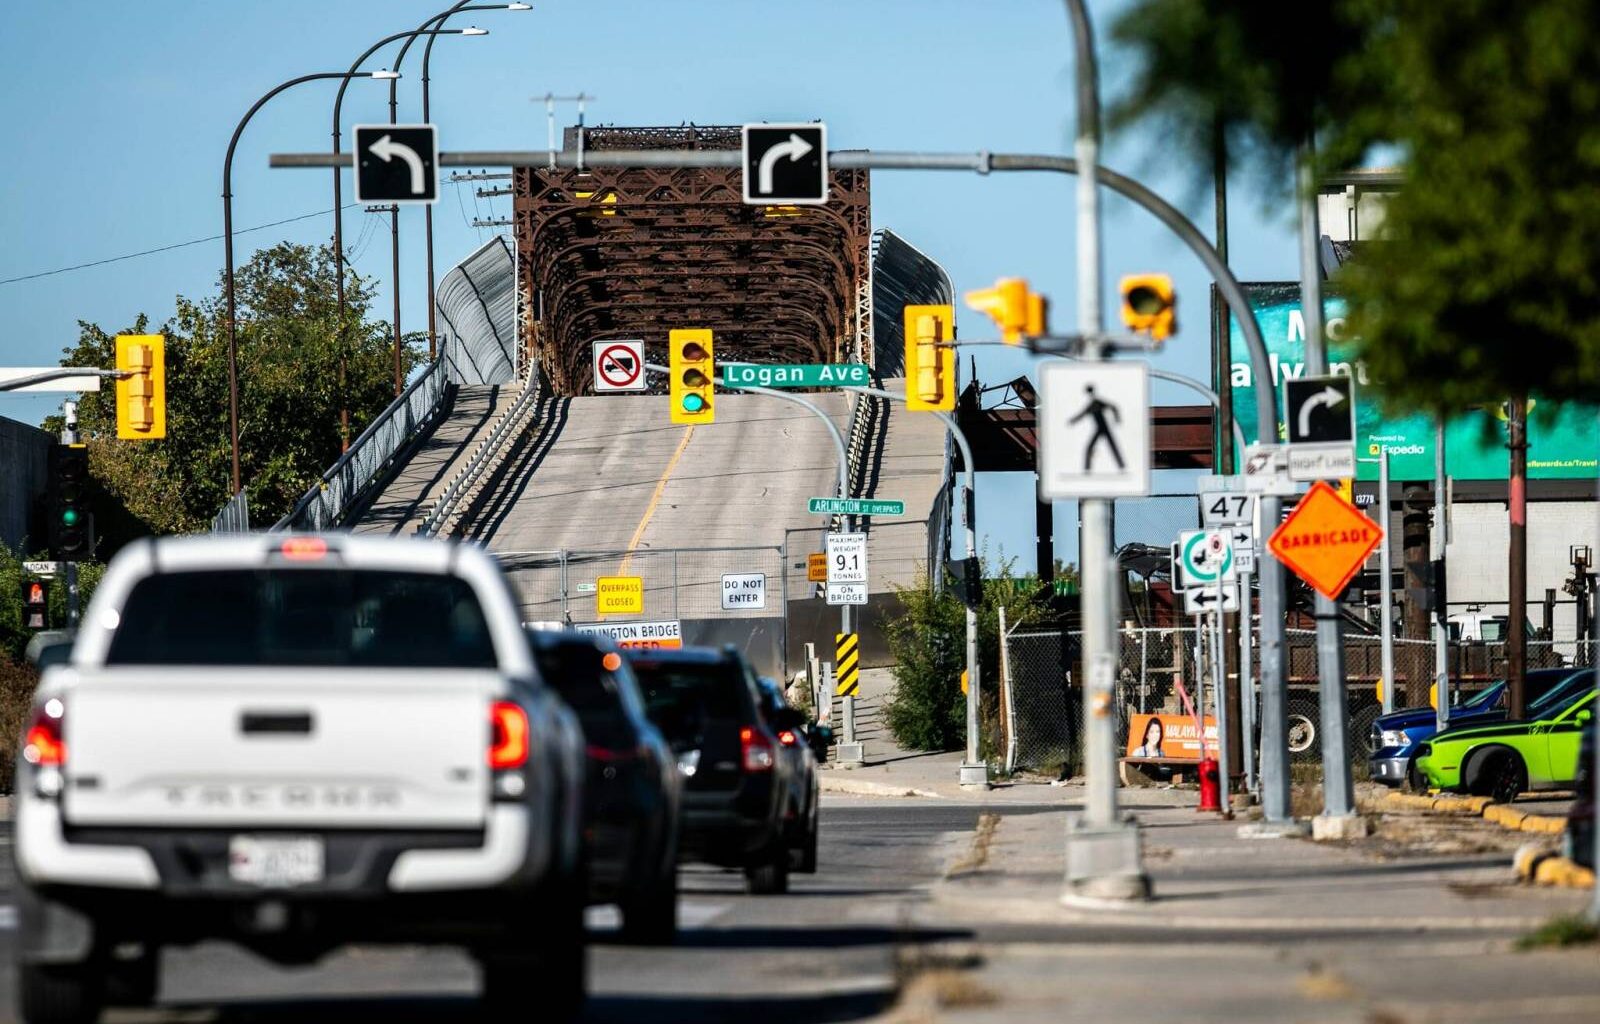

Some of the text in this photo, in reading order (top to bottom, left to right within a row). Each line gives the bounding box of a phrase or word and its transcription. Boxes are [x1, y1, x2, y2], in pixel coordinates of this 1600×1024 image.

[728, 366, 863, 386] Logan Ave
[1397, 434, 1406, 442] by
[1381, 444, 1425, 456] Expedia
[814, 500, 900, 513] ARLINGTON ST OVERPASS
[1210, 496, 1248, 517] 47
[1281, 528, 1369, 549] BARRICADE
[836, 554, 858, 571] 9.1
[601, 584, 640, 592] OVERPASS
[724, 580, 762, 589] DO NOT
[606, 598, 635, 606] CLOSED
[729, 594, 758, 602] ENTER
[642, 624, 679, 637] BRIDGE
